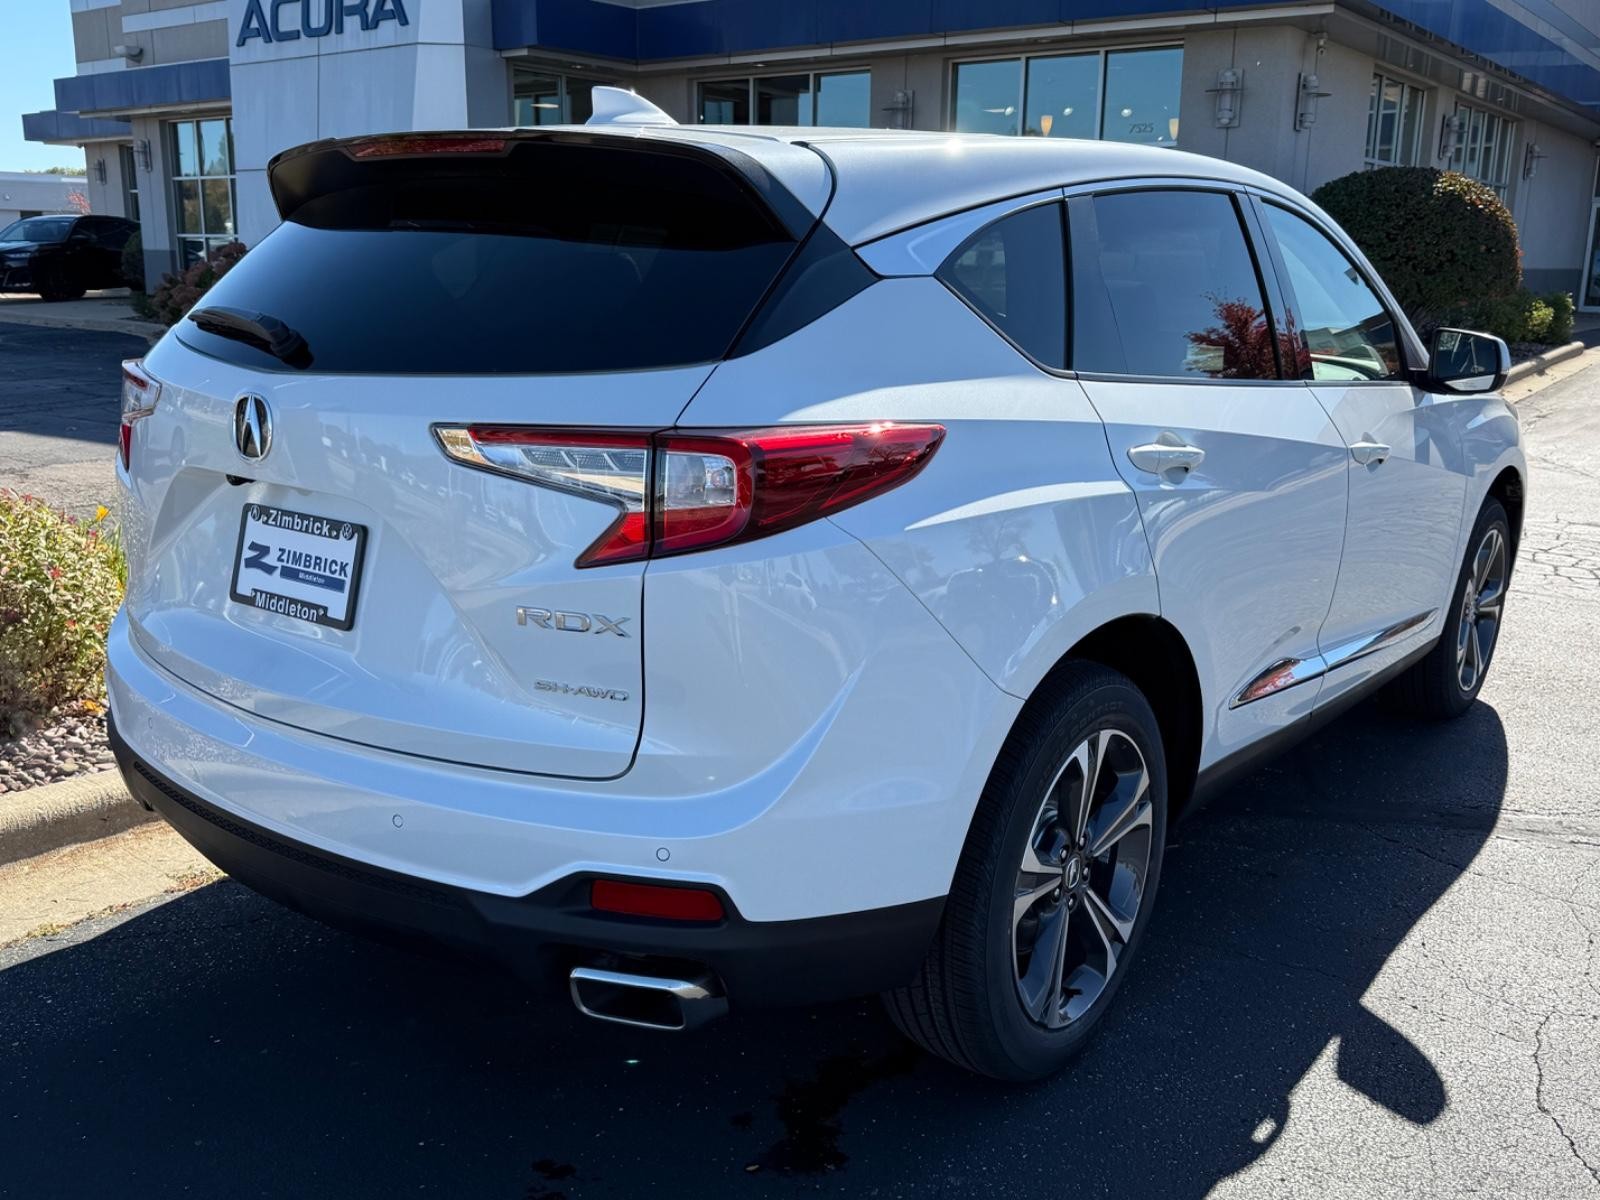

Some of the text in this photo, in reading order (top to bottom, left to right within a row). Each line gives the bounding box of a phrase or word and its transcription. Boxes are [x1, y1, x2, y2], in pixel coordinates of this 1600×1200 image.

[236, 0, 409, 47] ACURA
[1129, 122, 1154, 134] 7525
[268, 510, 331, 537] Zimbrick
[277, 547, 349, 578] ZIMBRICK
[254, 591, 317, 622] Middleton
[516, 605, 631, 638] RDX
[534, 679, 630, 702] SH-AWD
